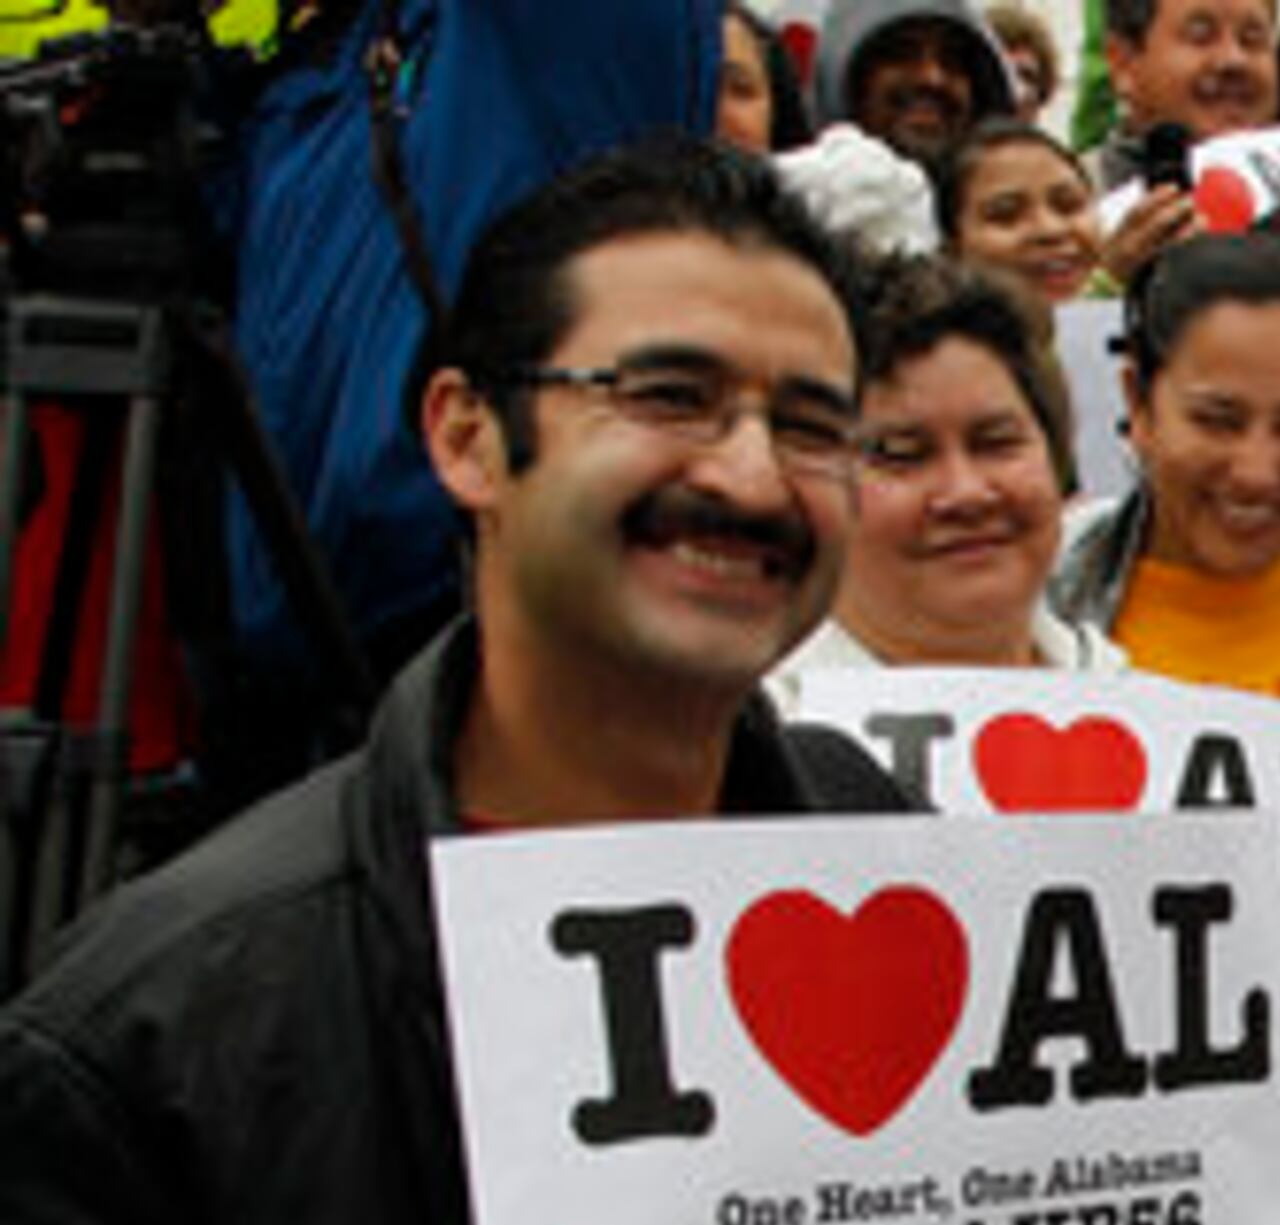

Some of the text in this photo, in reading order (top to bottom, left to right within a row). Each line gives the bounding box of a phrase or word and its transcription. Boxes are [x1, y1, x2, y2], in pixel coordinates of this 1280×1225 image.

[549, 882, 1272, 1146] I AL
[960, 1167, 1042, 1208] One
[1048, 1149, 1203, 1193] Alabama
